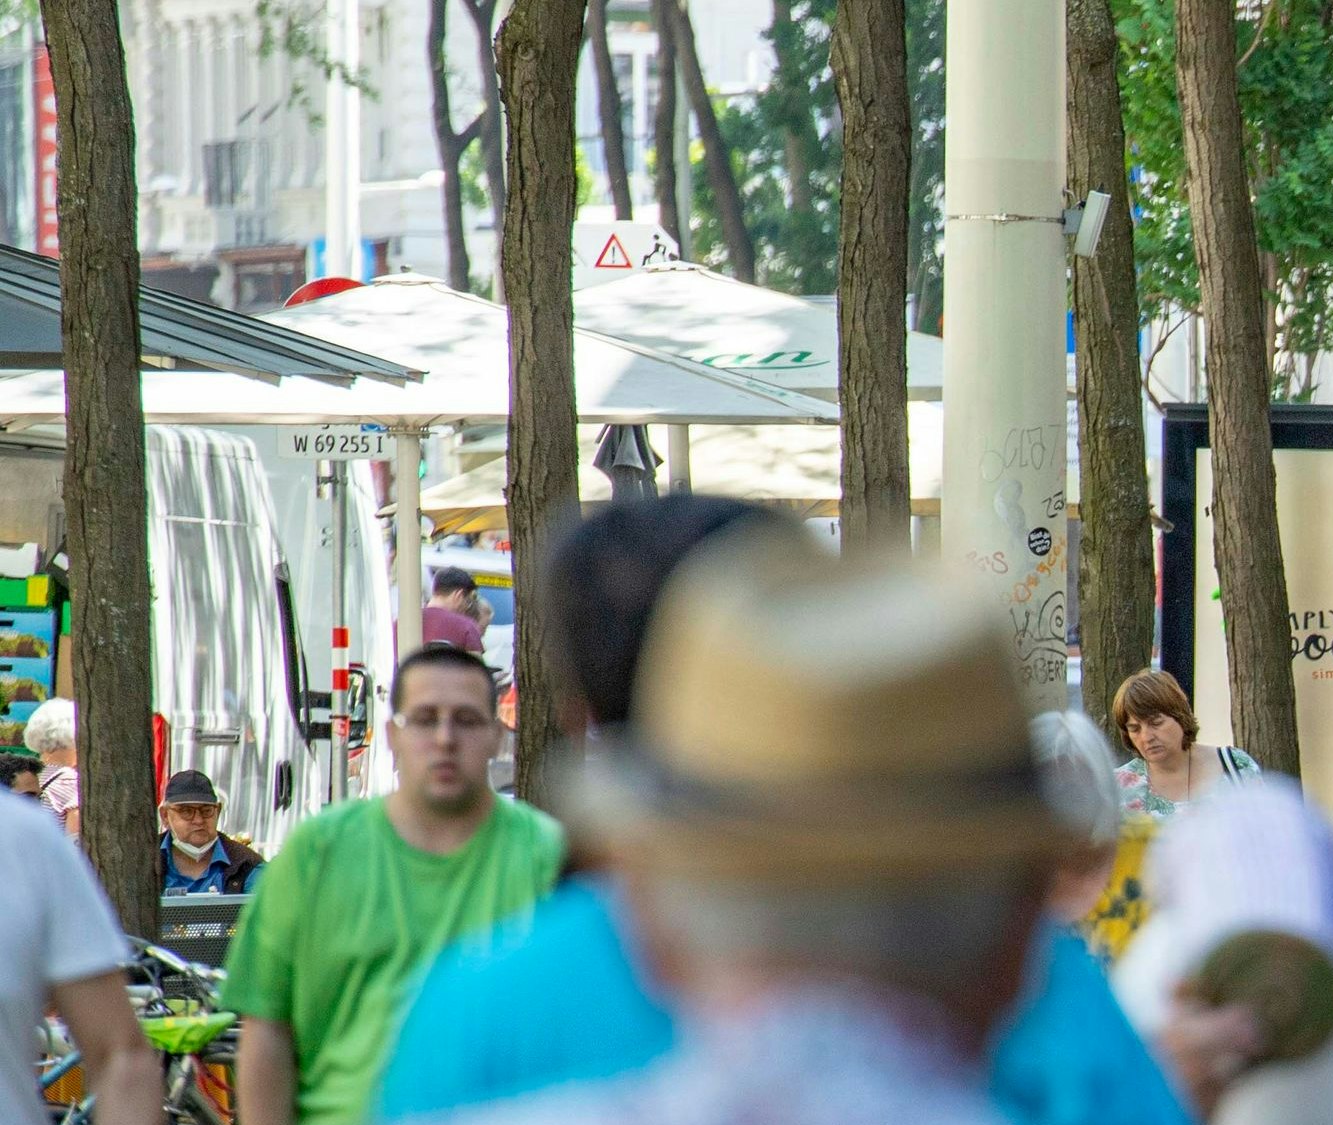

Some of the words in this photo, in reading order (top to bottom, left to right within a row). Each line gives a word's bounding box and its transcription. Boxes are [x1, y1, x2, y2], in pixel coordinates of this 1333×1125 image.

[294, 435, 308, 453] W
[315, 435, 336, 453] 69
[340, 435, 370, 454] 255
